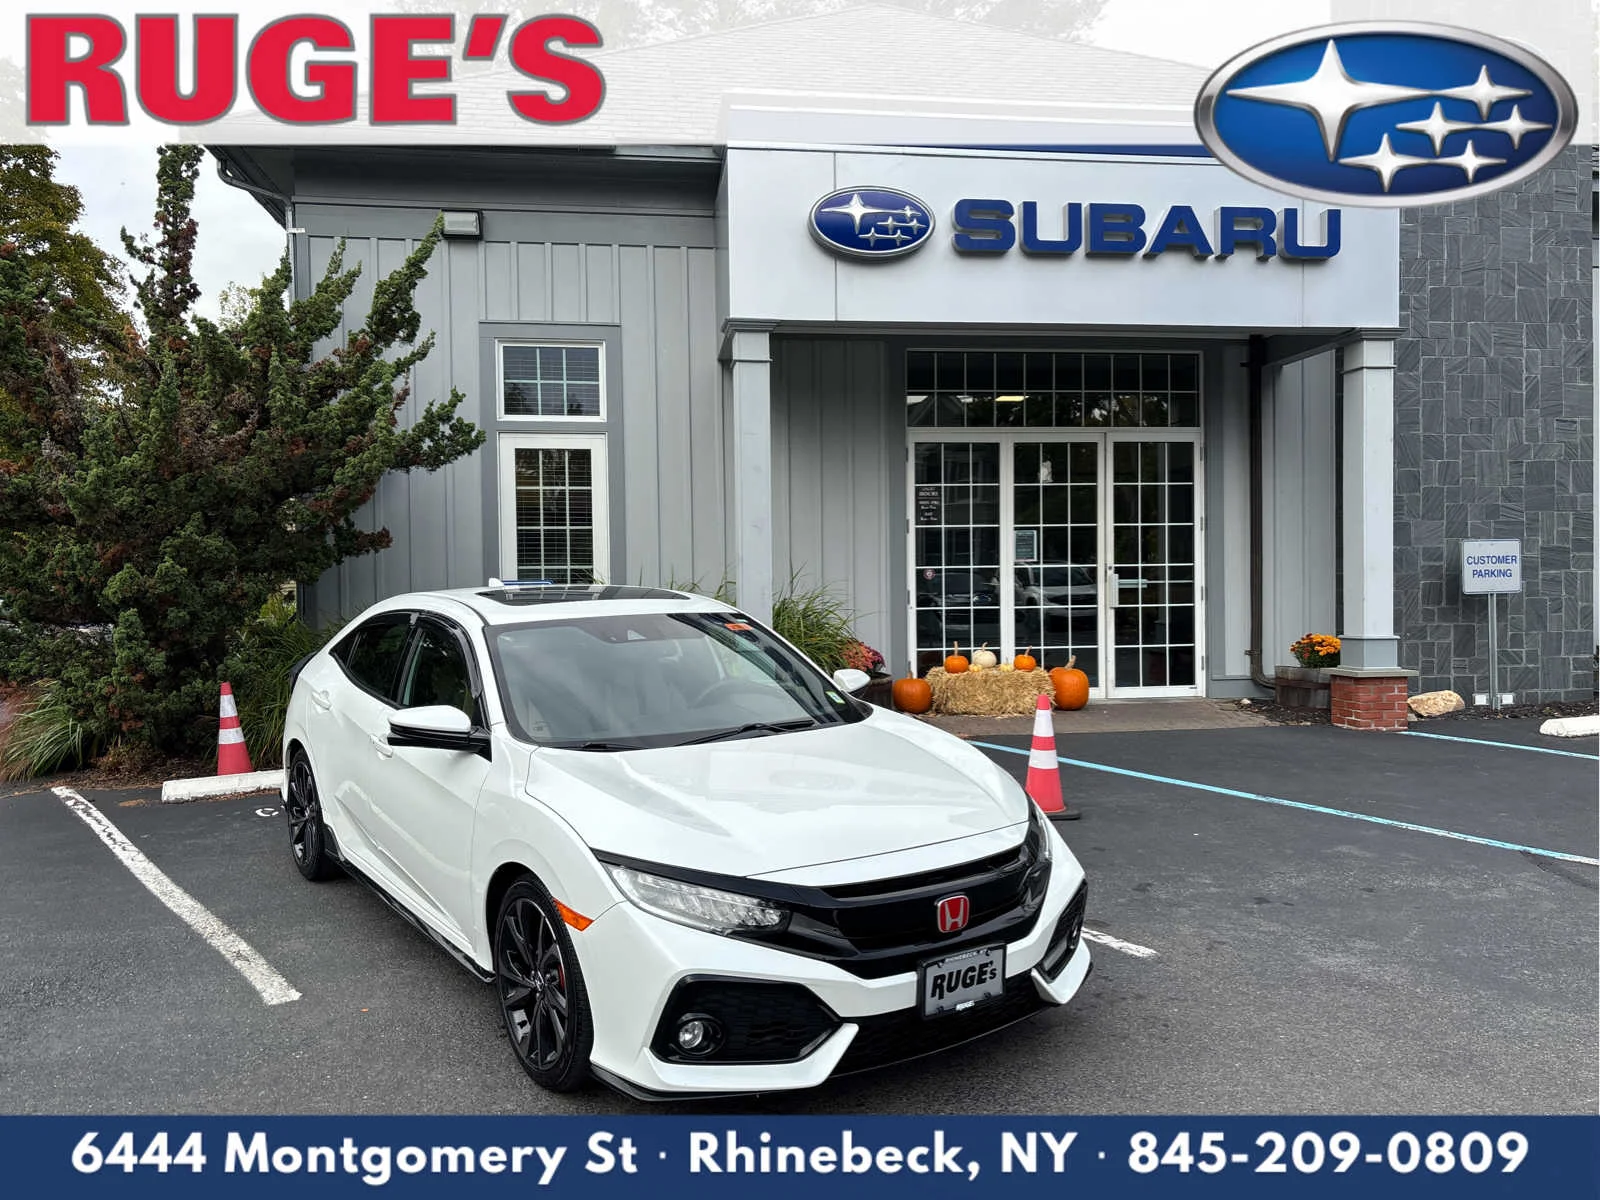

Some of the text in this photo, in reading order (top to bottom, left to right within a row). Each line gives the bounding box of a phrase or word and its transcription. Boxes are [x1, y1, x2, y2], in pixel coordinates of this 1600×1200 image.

[952, 199, 1342, 260] SUBARU
[1466, 555, 1517, 565] CUSTOMER
[1472, 568, 1513, 578] PARKING
